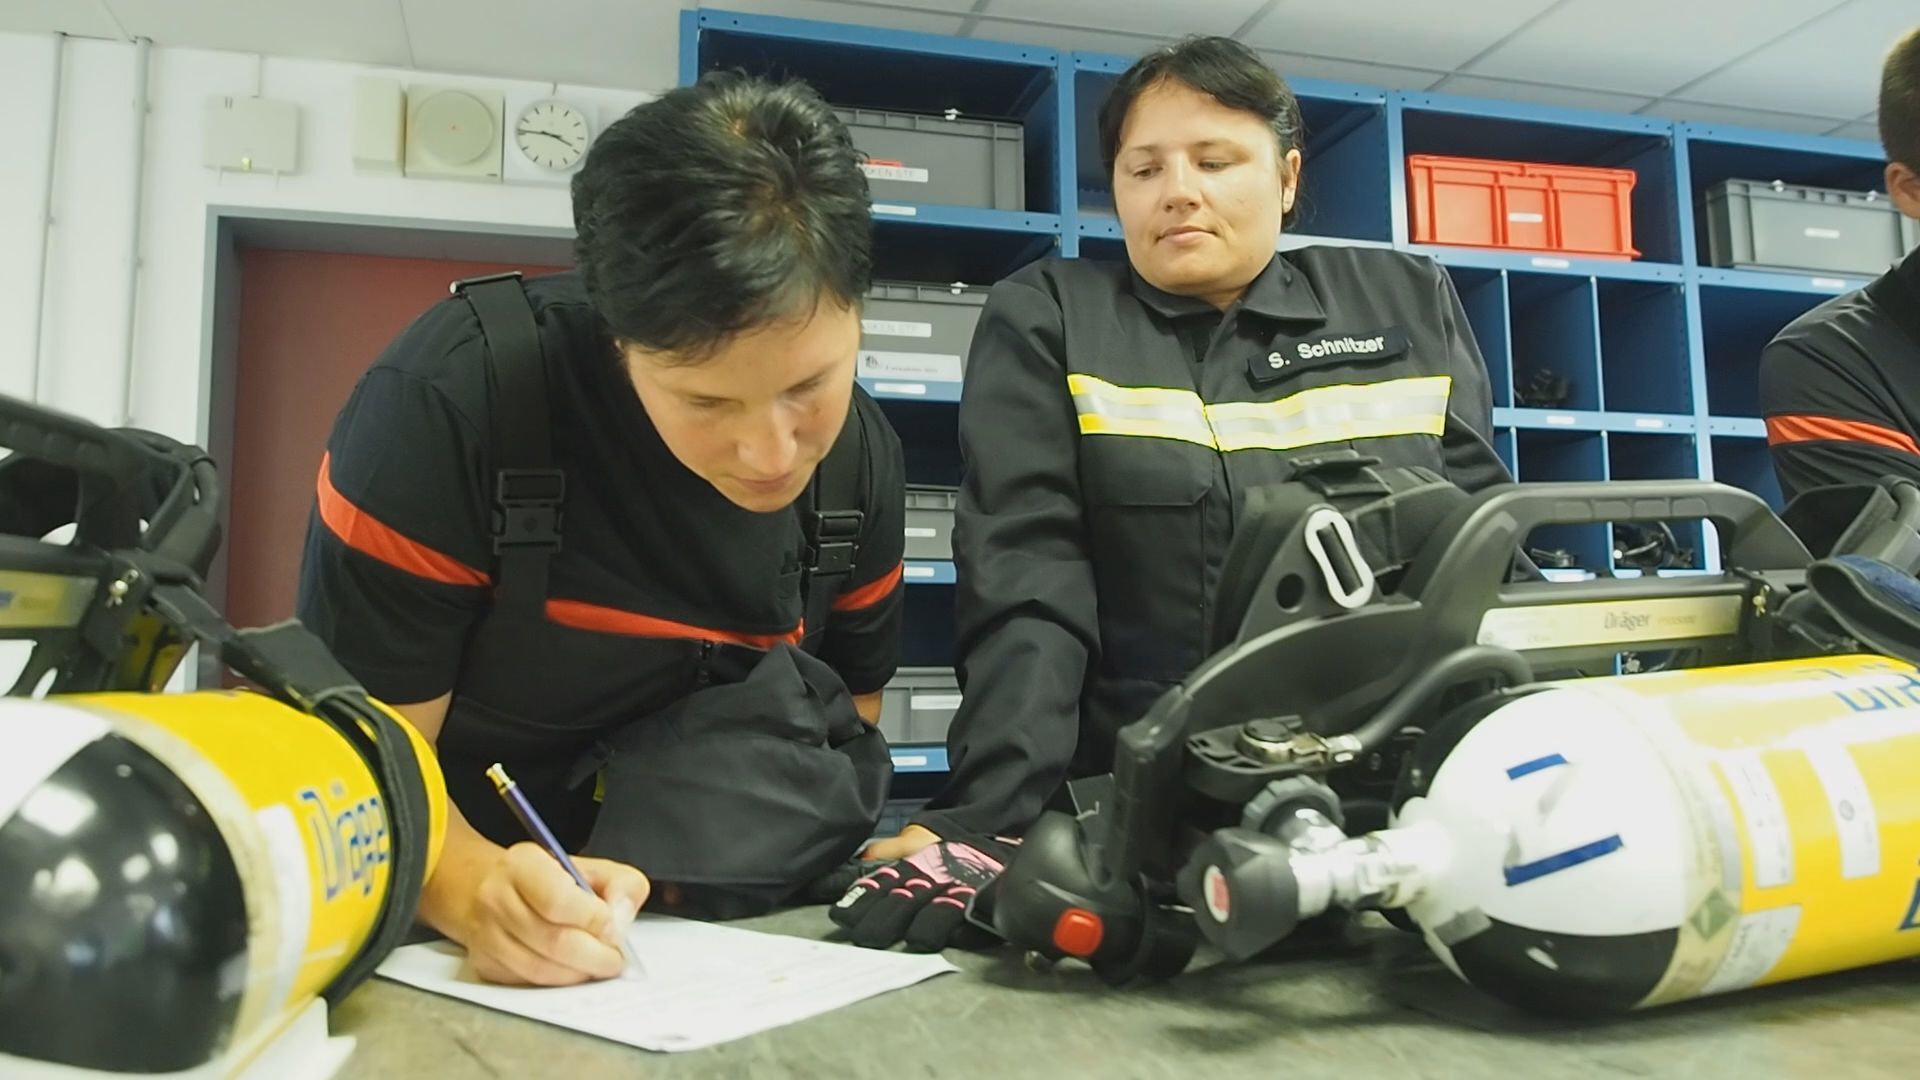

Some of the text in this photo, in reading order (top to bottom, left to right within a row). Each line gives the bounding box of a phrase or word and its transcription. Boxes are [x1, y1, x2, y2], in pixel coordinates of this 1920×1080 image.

[1268, 336, 1384, 368] S. Schnitzer
[1604, 609, 1650, 631] Dräger
